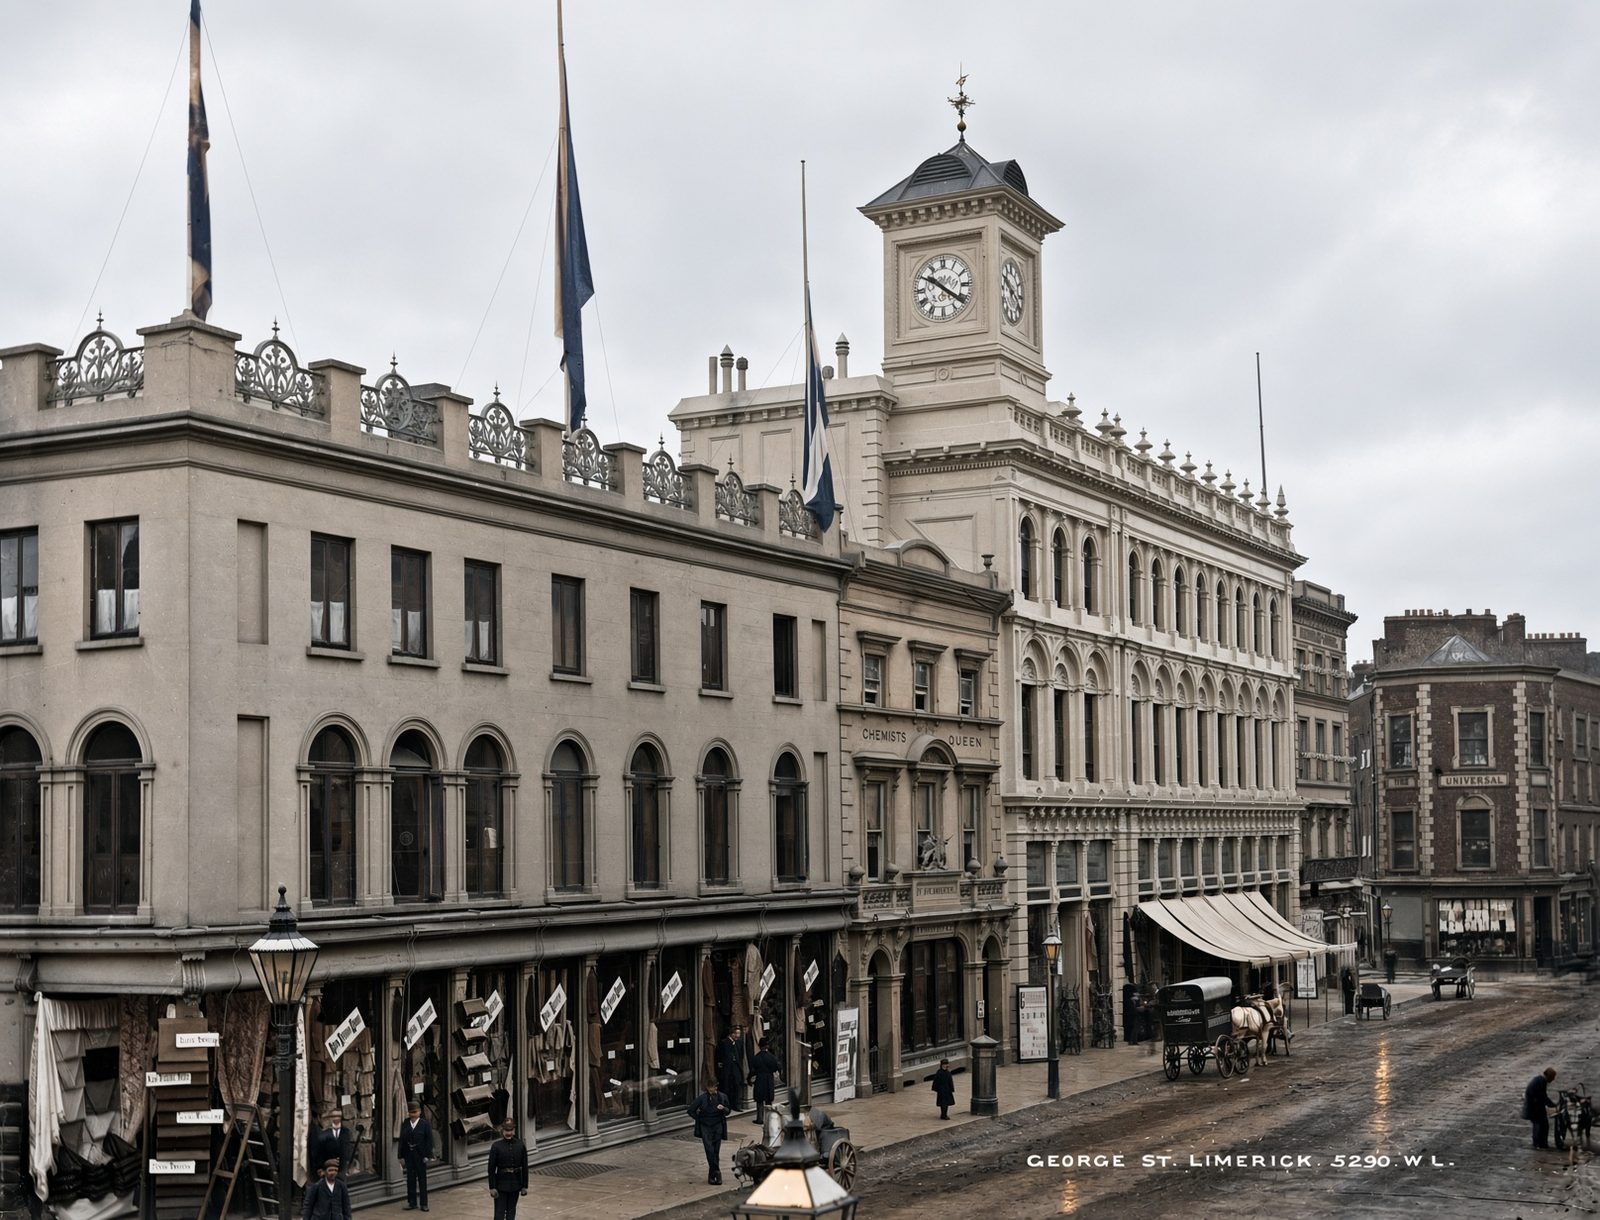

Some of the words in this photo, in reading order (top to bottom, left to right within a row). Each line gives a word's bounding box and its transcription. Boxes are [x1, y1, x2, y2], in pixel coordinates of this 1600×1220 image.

[862, 728, 907, 743] CHEMISTS
[948, 735, 982, 747] QUEEN
[1446, 776, 1503, 785] UNIVERSAL
